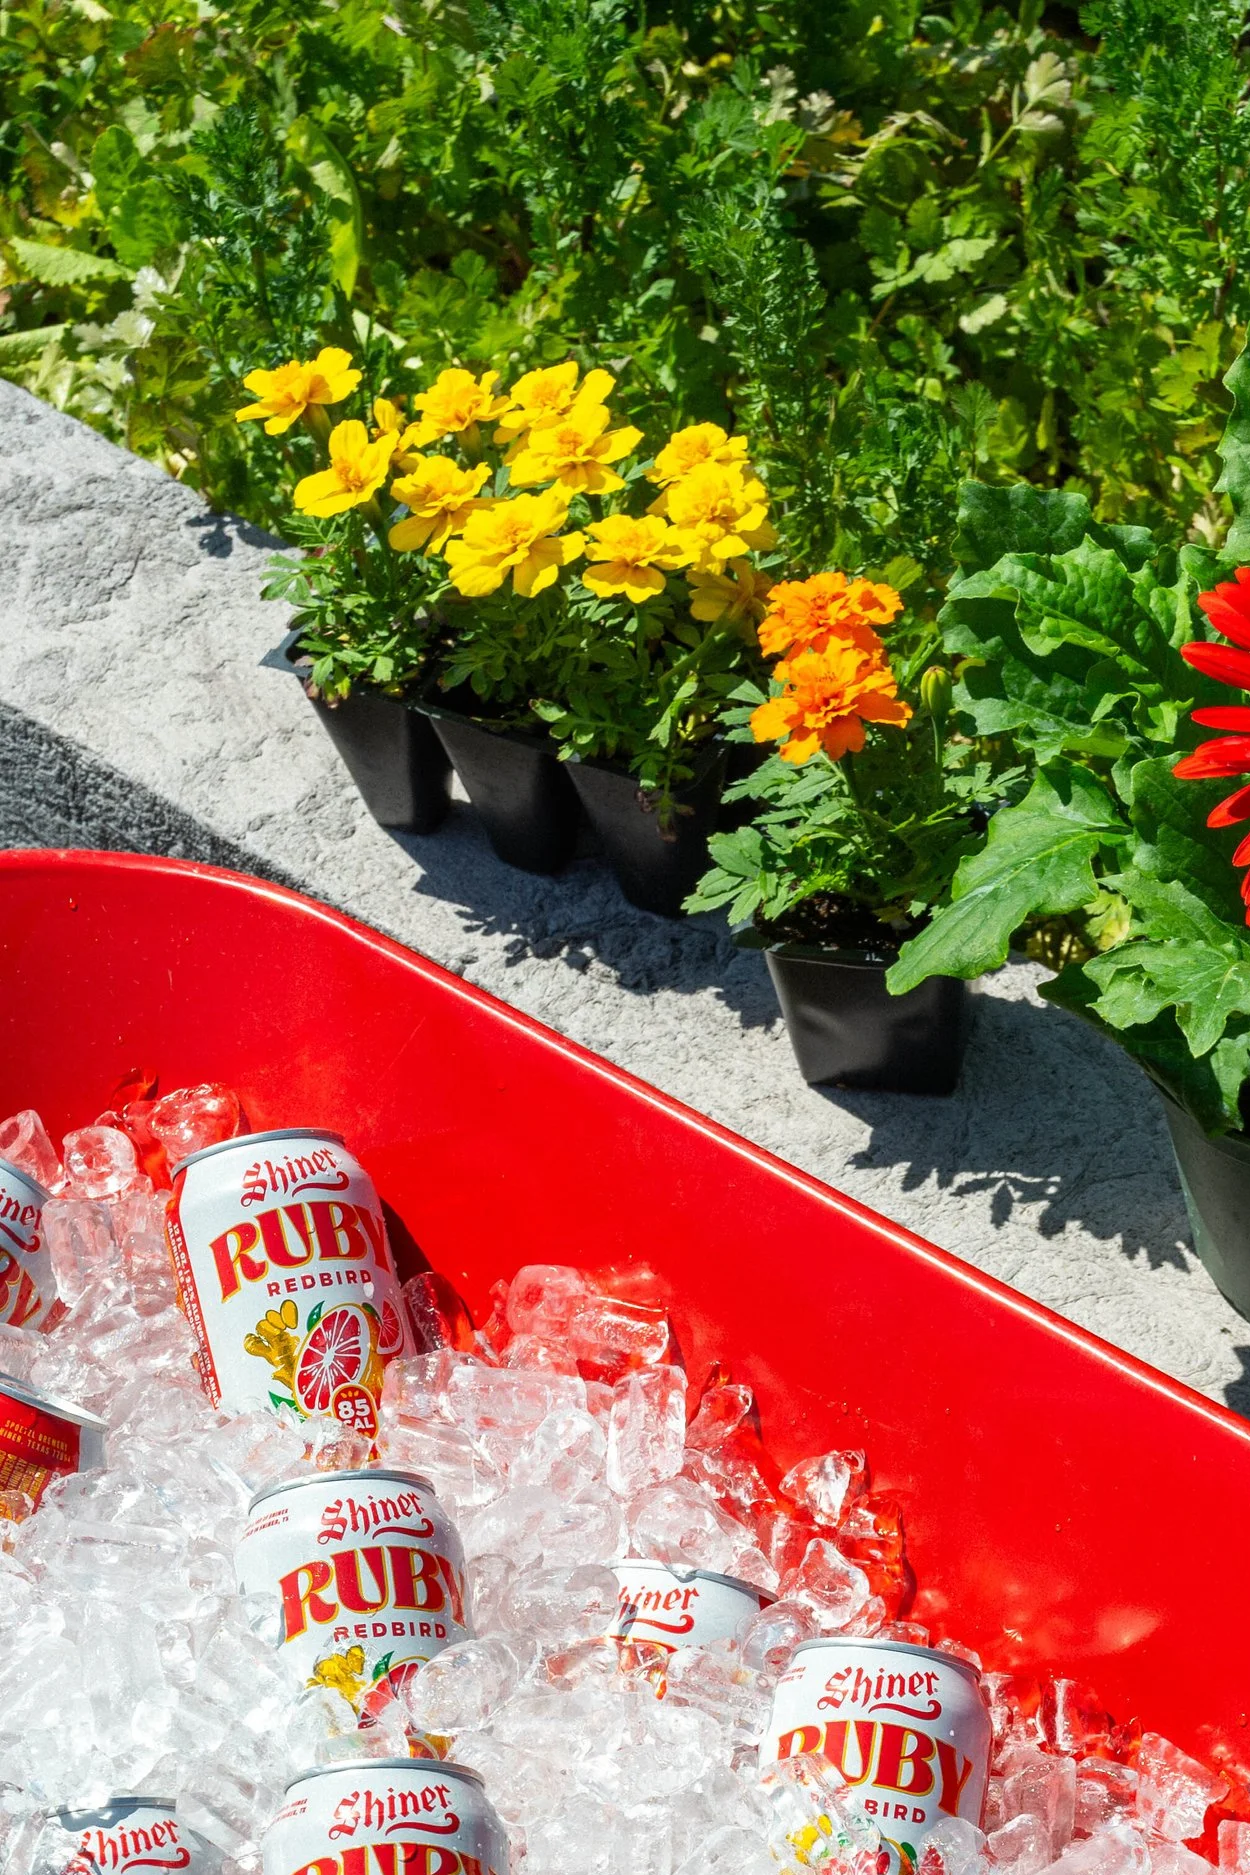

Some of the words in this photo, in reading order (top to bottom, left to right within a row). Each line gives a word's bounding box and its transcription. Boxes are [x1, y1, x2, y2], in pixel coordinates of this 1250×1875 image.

[241, 1147, 336, 1207] Shiner
[208, 1200, 392, 1302] RUBY
[266, 1268, 373, 1298] REDBIRD
[338, 1397, 371, 1420] 85
[317, 1491, 422, 1545] Shiner
[278, 1545, 467, 1644] RUBY
[617, 1585, 700, 1622] hiner
[333, 1622, 447, 1643] REDBIRD
[816, 1666, 941, 1711] Shiner
[328, 1783, 452, 1840] Shiner
[864, 1799, 927, 1825] BIRD
